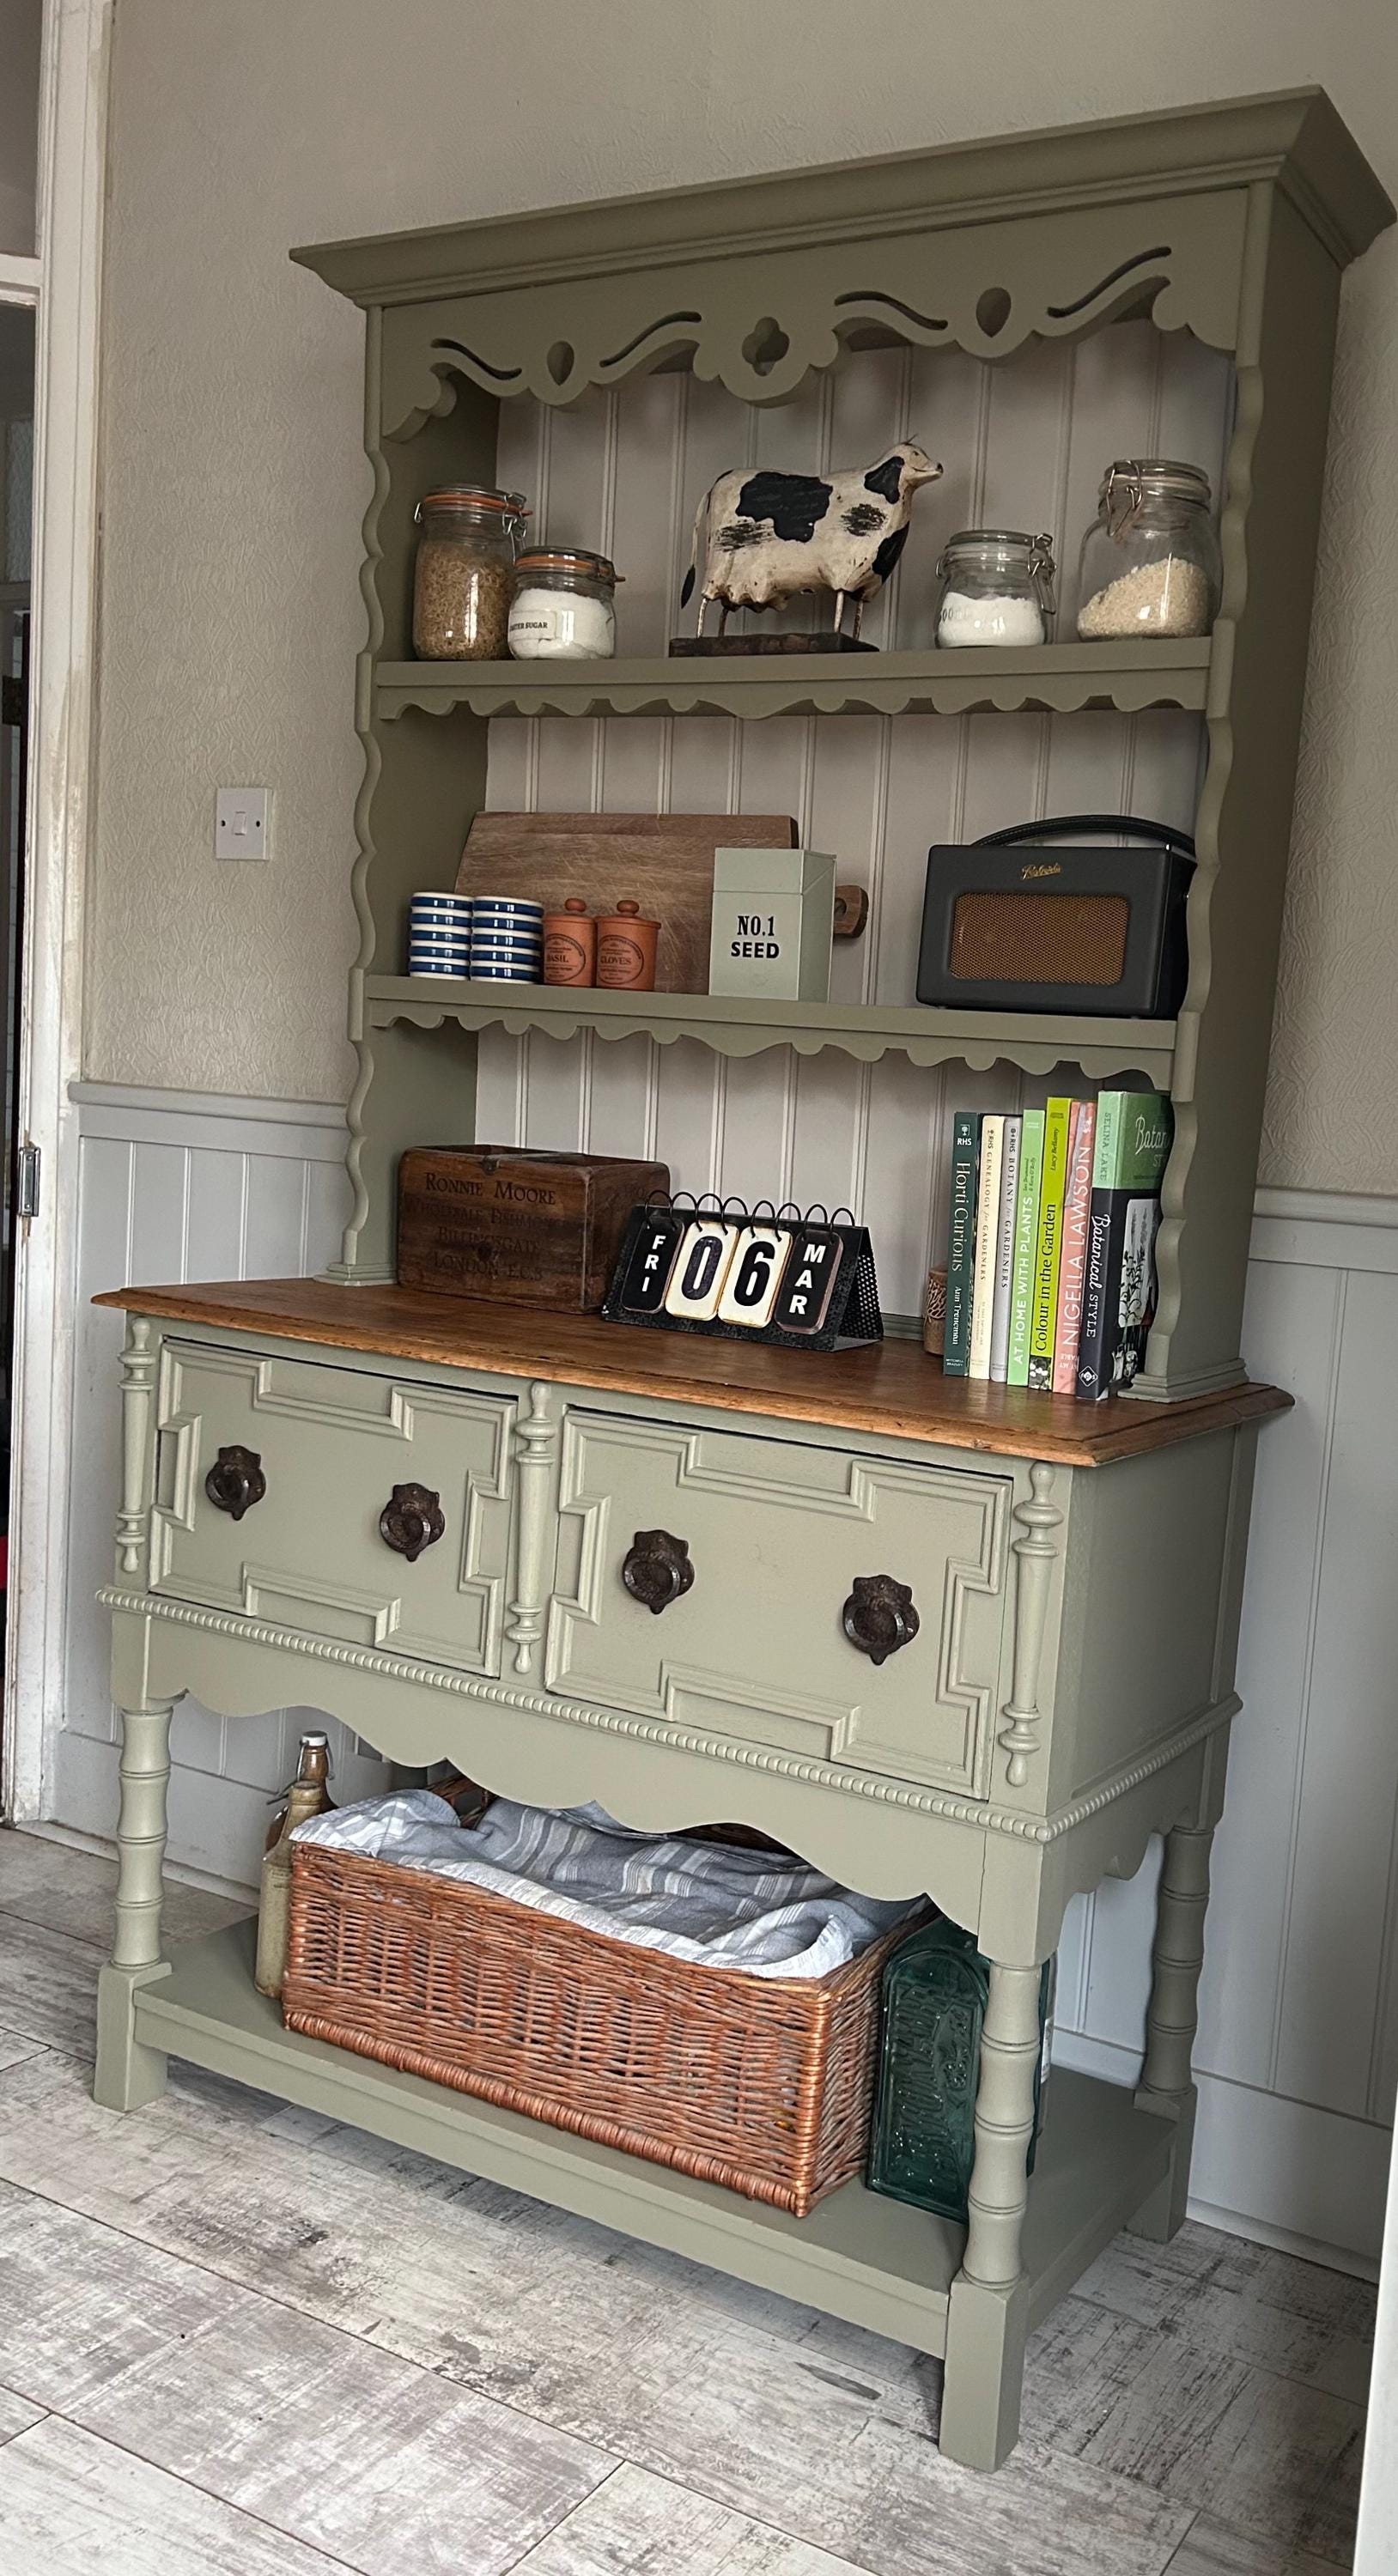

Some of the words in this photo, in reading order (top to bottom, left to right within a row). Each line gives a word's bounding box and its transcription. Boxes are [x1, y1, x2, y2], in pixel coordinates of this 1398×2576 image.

[737, 915, 775, 936] NO.1
[601, 955, 632, 965] CLOVES
[731, 942, 780, 958] SEED
[957, 1138, 971, 1146] RHS
[1051, 1127, 1060, 1154] Bellamy
[1103, 1113, 1111, 1148] SELINA
[955, 1163, 970, 1203] Horti
[984, 1152, 993, 1207] GENEALOGY
[1006, 1157, 1015, 1203] BOTANY
[1100, 1153, 1109, 1181] LAKE
[426, 1172, 483, 1196] RONNIE
[494, 1181, 557, 1205] MOORE
[1068, 1147, 1091, 1246] LAWSON
[951, 1207, 969, 1272] Curious
[1020, 1197, 1033, 1252] PLANTS
[1042, 1204, 1056, 1256] Garden
[432, 1251, 498, 1276] LONDON
[1002, 1220, 1012, 1288] GARDENERS
[1039, 1259, 1052, 1281] the
[1089, 1214, 1111, 1290] Botanical
[641, 1235, 666, 1291] FRI
[788, 1243, 826, 1315] MAR
[1018, 1257, 1030, 1295] WITH
[1015, 1300, 1026, 1342] HOME
[1062, 1255, 1084, 1346] NIGELLA
[1086, 1293, 1098, 1337] STYLE
[1036, 1304, 1048, 1351] Colour
[1014, 1346, 1024, 1364] AT
